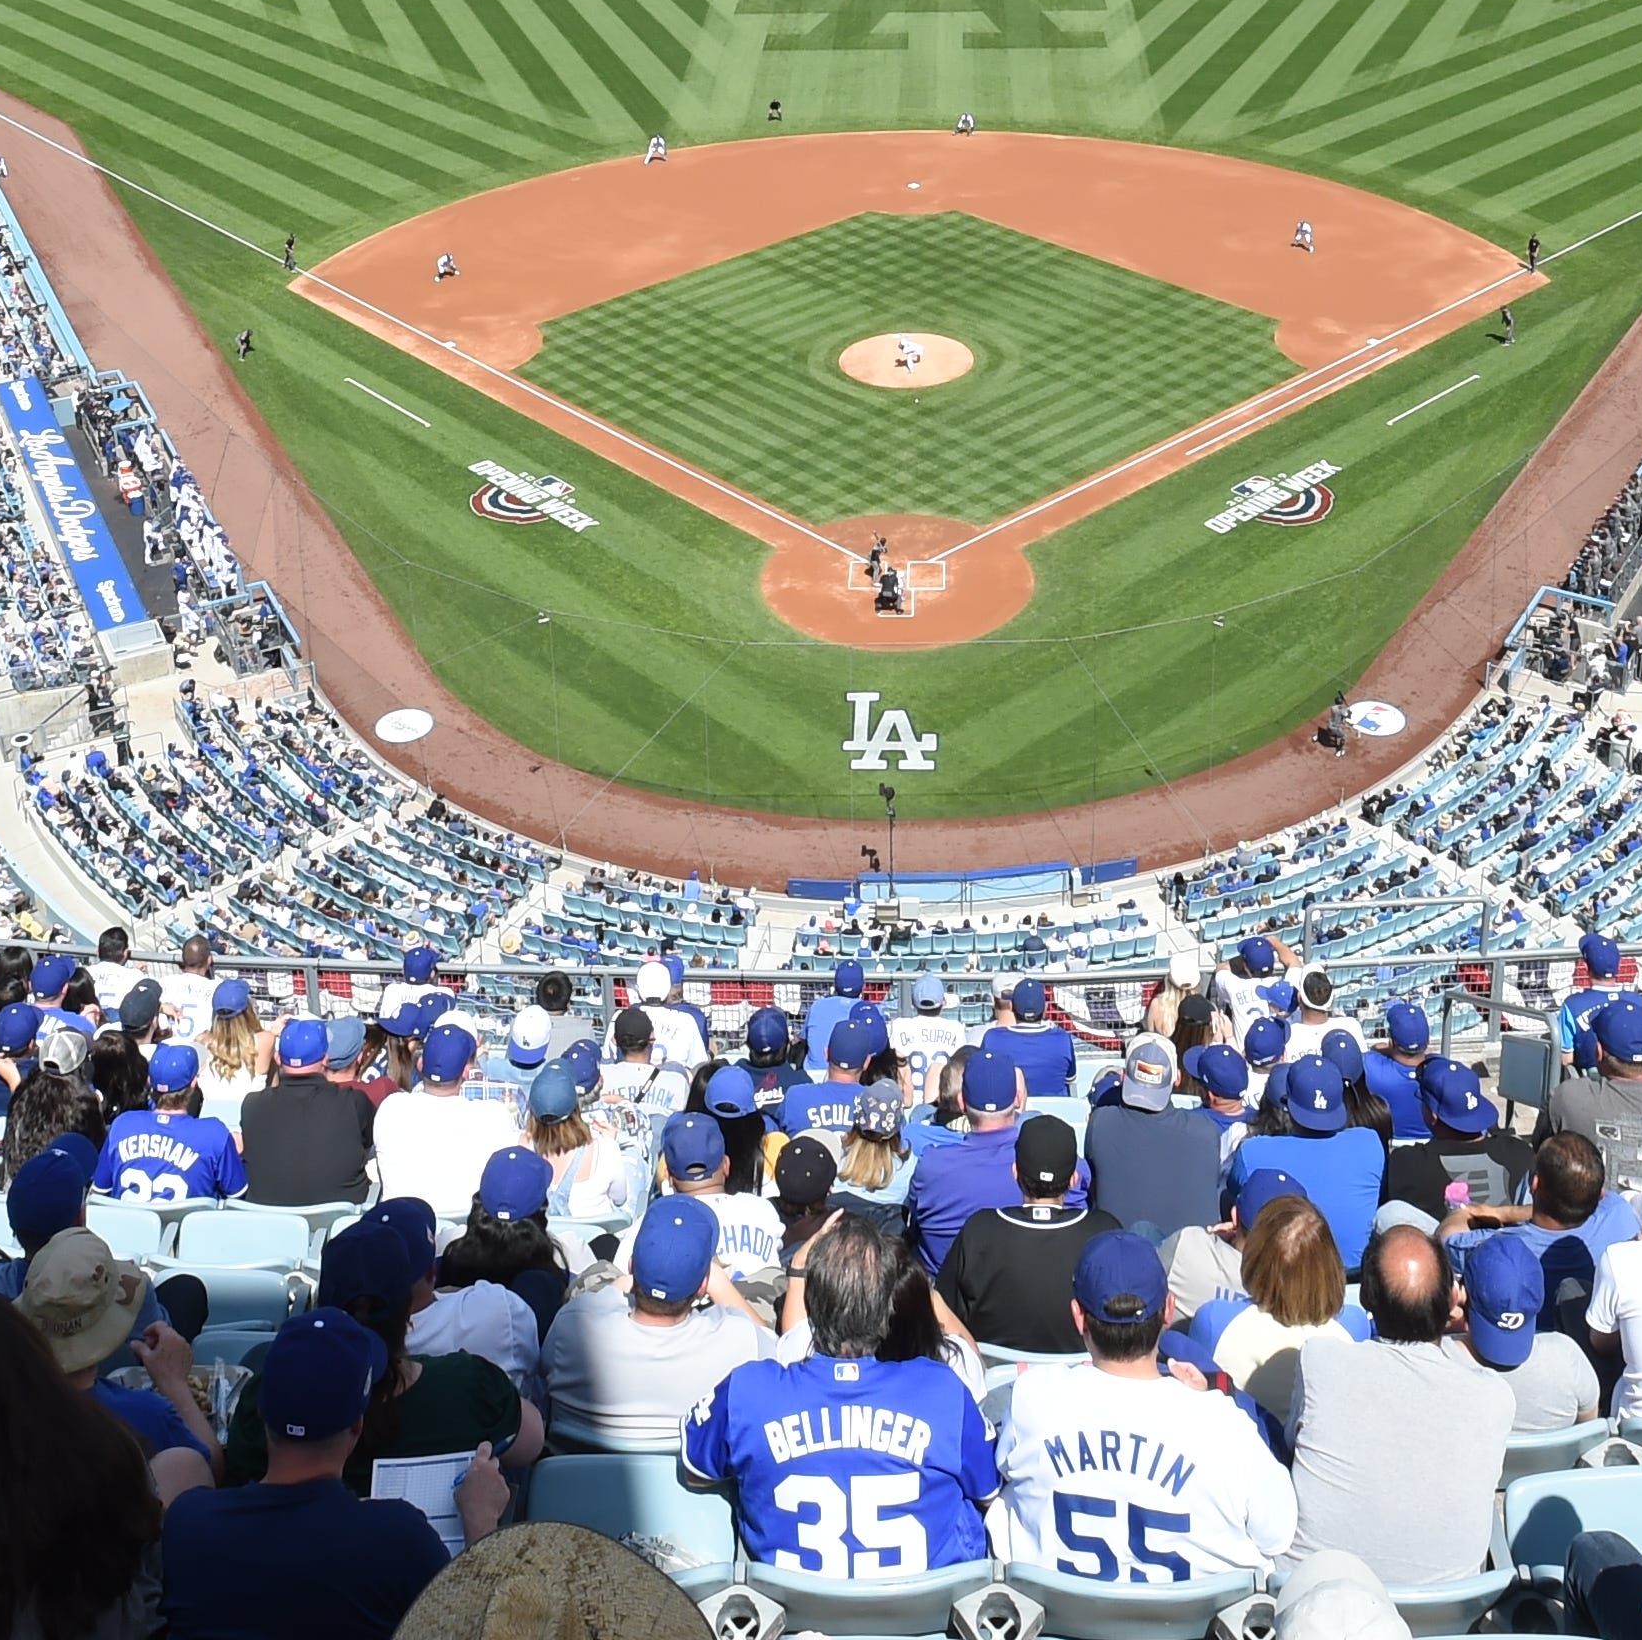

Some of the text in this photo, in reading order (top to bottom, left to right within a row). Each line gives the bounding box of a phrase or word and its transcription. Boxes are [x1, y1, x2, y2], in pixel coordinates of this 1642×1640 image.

[467, 459, 601, 533] OPENING WEEK
[1204, 459, 1343, 534] OPENING WEEK
[43, 497, 95, 560] Dodgers
[842, 691, 938, 771] LA
[900, 1030, 918, 1048] De
[1314, 1089, 1328, 1110] LA
[1464, 1090, 1480, 1111] LA
[118, 1133, 199, 1172] KERSHAW
[119, 1168, 189, 1202] 22
[716, 1223, 774, 1264] CHADO
[763, 1404, 932, 1466] BELLINGER
[1043, 1431, 1197, 1498] MARTIN
[773, 1472, 929, 1581] 35
[1052, 1490, 1193, 1584] 55
